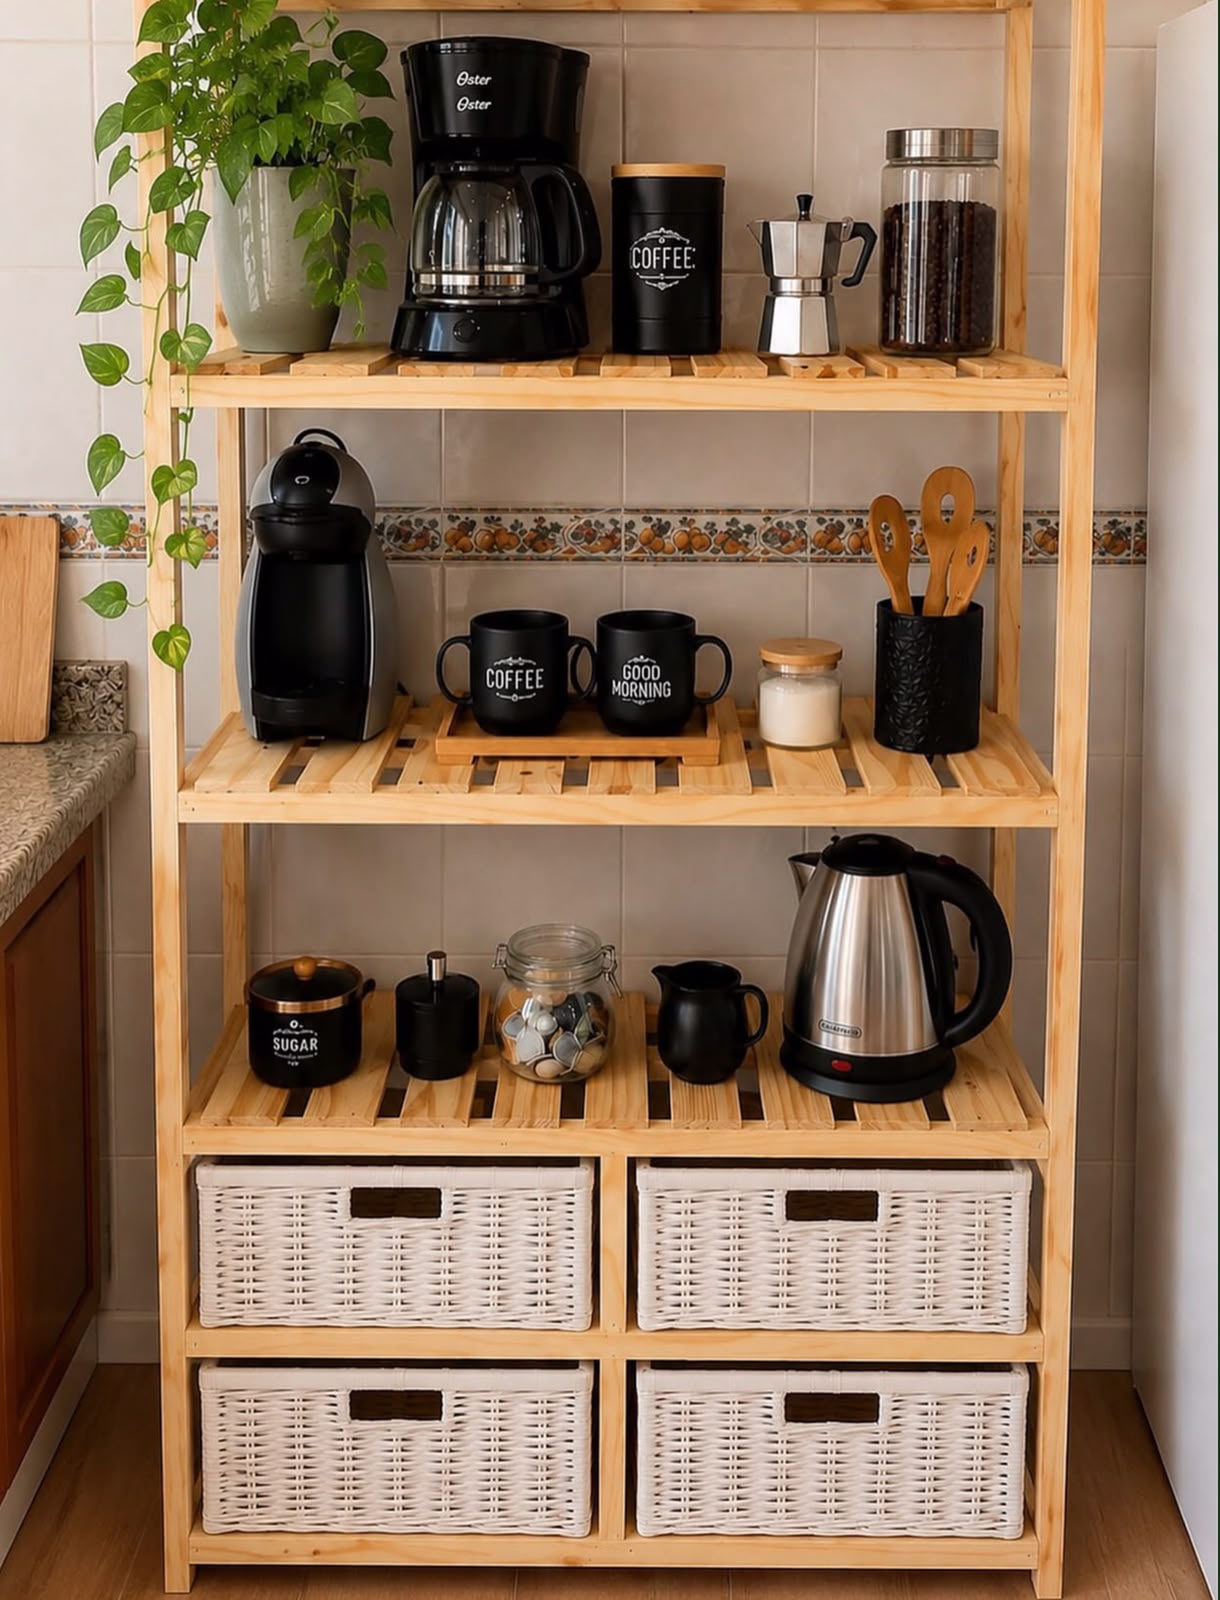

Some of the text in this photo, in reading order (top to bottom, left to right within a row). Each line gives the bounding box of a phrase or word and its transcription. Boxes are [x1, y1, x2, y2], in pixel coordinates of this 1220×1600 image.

[456, 71, 492, 87] Oster
[456, 96, 492, 112] Oster
[486, 668, 545, 690] COFFEE
[622, 664, 661, 681] GOOD
[612, 680, 671, 698] MORNING
[272, 1036, 318, 1053] SUGAR
